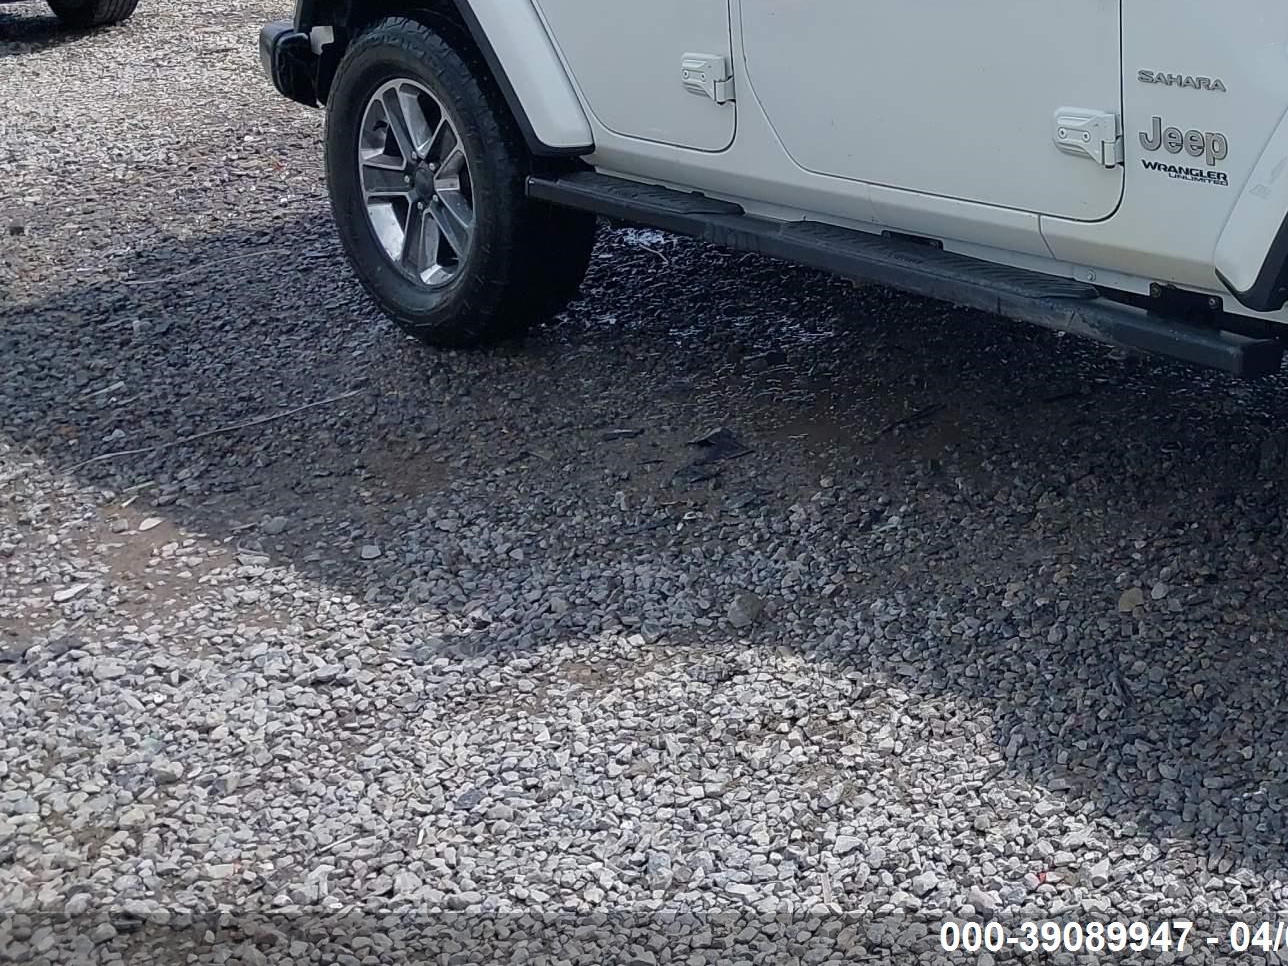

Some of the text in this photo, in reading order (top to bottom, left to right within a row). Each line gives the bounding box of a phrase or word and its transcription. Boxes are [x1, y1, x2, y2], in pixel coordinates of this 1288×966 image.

[1138, 70, 1227, 92] SAHARA
[1139, 116, 1228, 166] Jeep
[1141, 159, 1228, 181] WRANGLER
[1168, 172, 1229, 186] UNLIMITED
